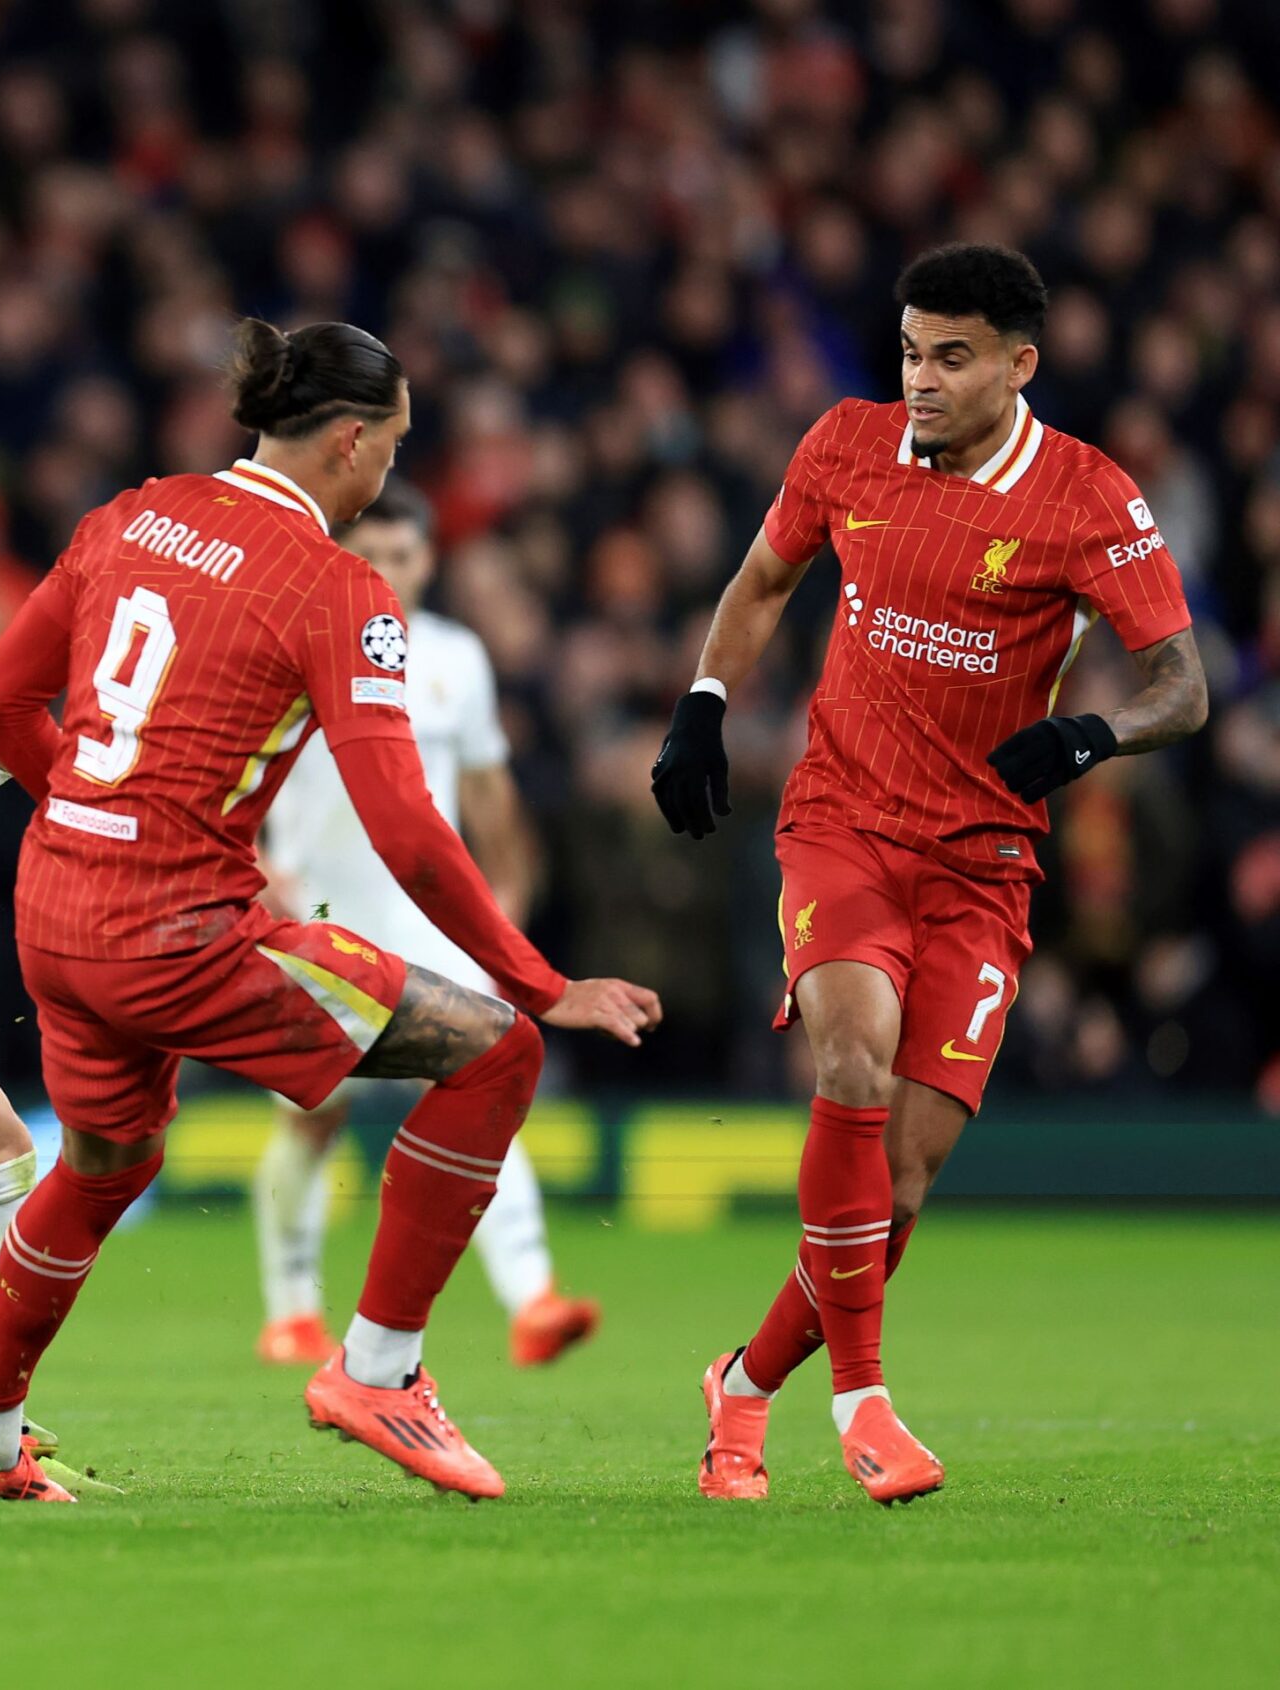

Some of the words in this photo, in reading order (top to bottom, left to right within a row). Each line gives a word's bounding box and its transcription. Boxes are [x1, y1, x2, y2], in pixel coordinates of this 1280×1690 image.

[122, 509, 245, 583] DARWIN
[868, 629, 999, 674] chartered
[872, 606, 996, 651] standard
[73, 585, 178, 789] 9
[966, 961, 1006, 1045] 7
